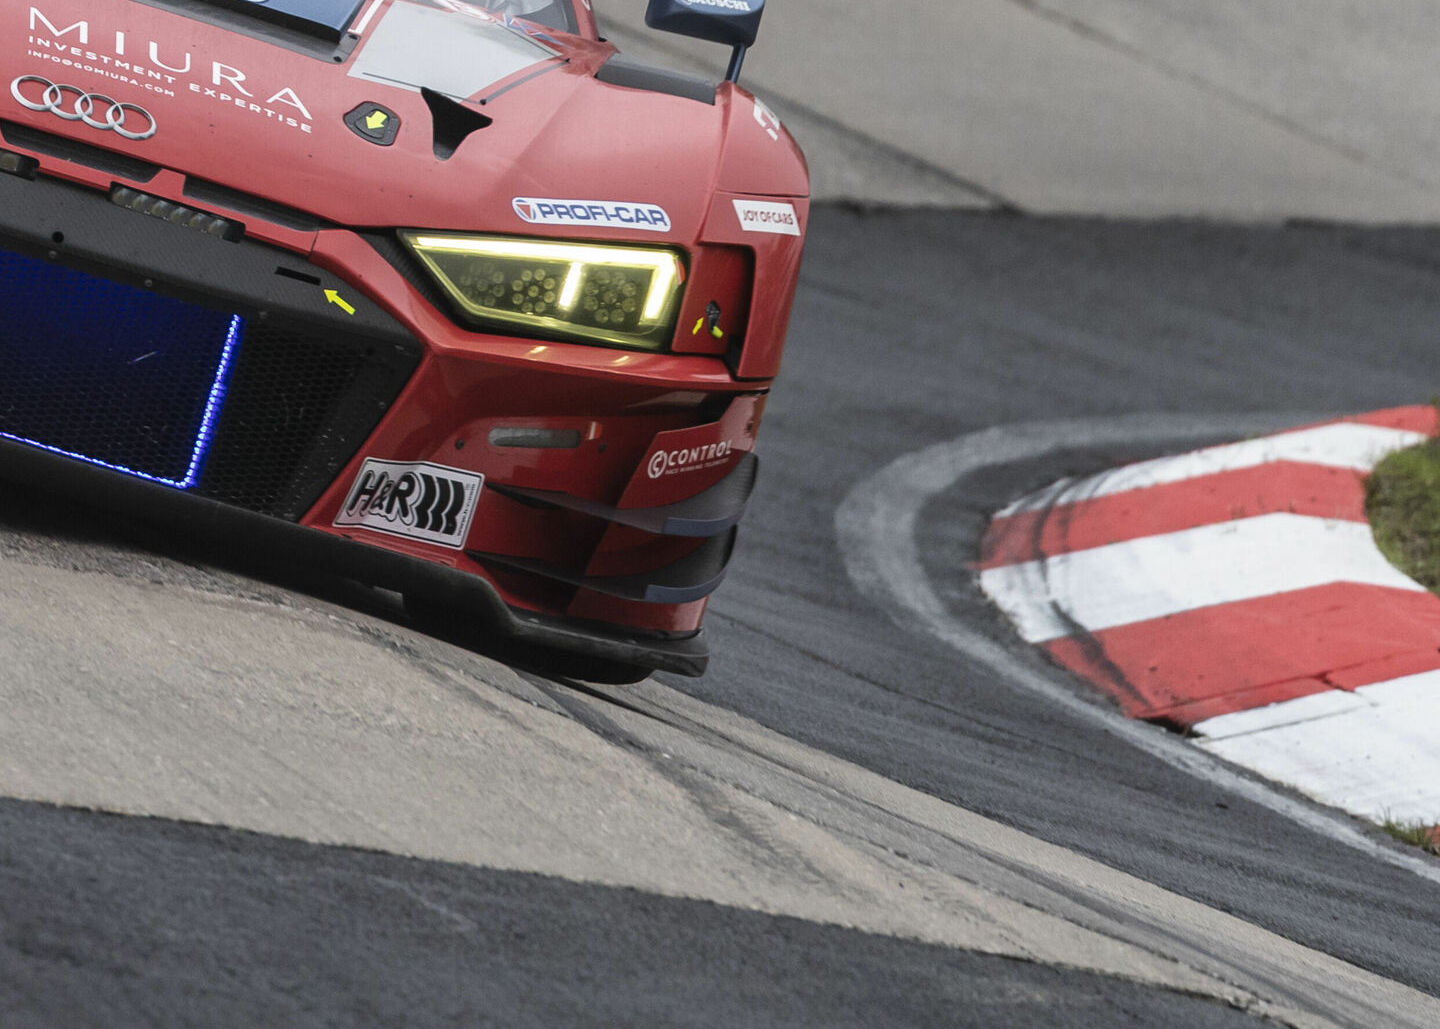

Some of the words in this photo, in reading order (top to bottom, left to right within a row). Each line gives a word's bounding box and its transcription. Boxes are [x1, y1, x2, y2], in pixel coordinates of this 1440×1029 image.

[27, 49, 175, 97] INFO@GOMIURA.COM
[28, 35, 176, 85] INVESTMENT
[189, 82, 313, 134] EXPERTISE
[29, 6, 313, 121] MIURA
[536, 202, 668, 227] PROFI-CAR
[667, 439, 733, 467] CONTROL
